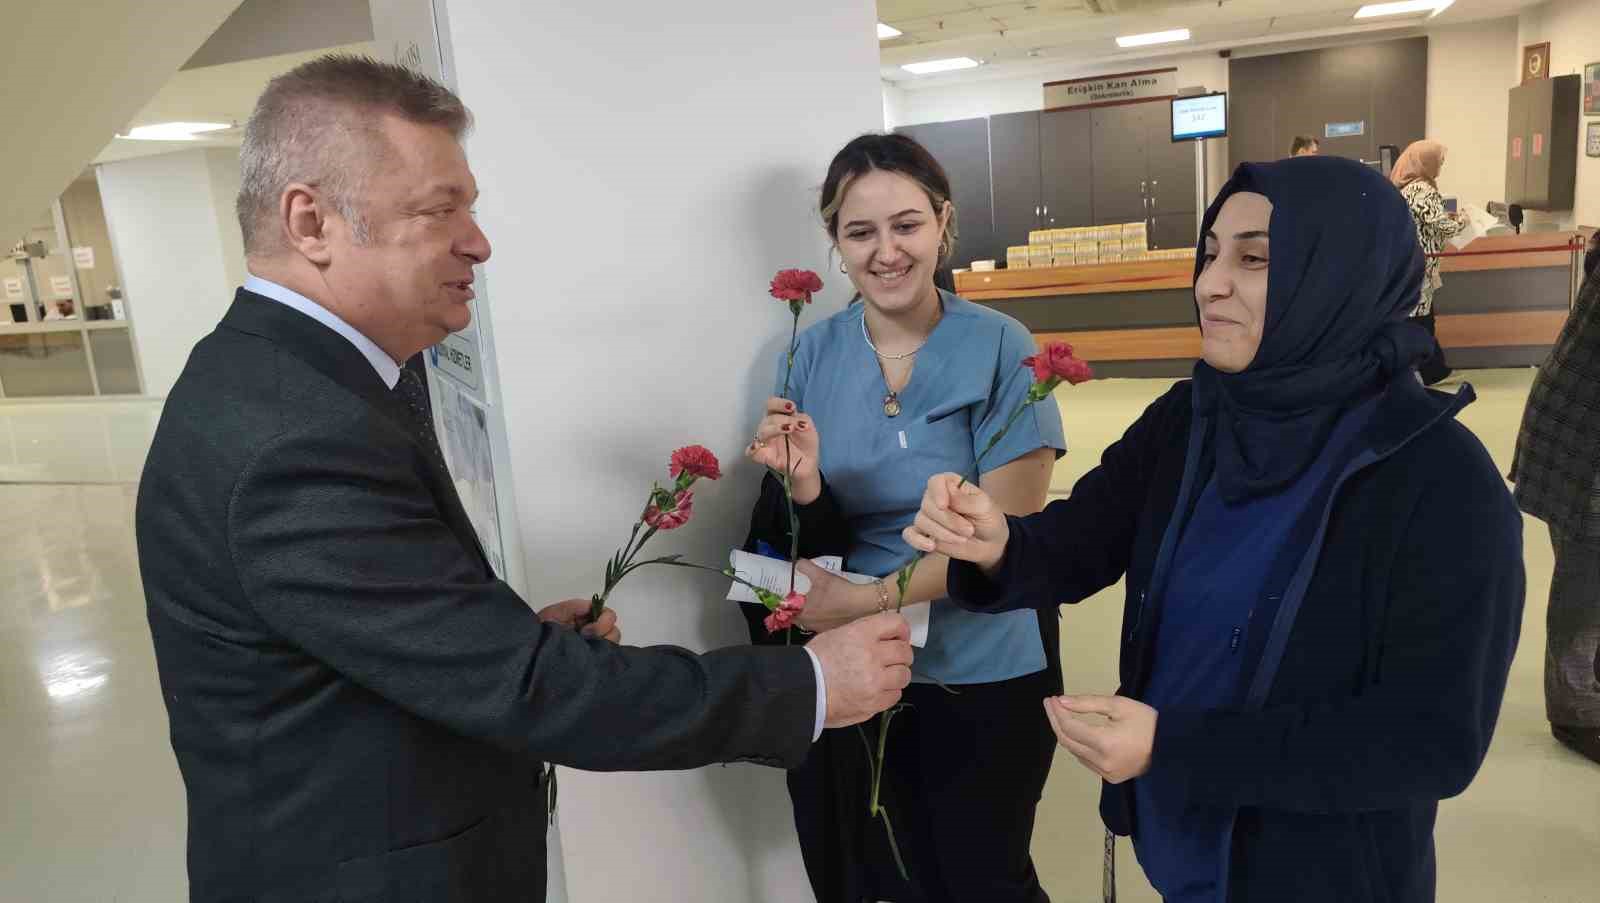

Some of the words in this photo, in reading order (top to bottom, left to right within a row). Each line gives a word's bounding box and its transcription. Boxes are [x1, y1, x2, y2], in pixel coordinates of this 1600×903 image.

[1067, 82, 1104, 95] Erişkin
[1106, 80, 1128, 90] Kan
[1130, 78, 1158, 88] Alma
